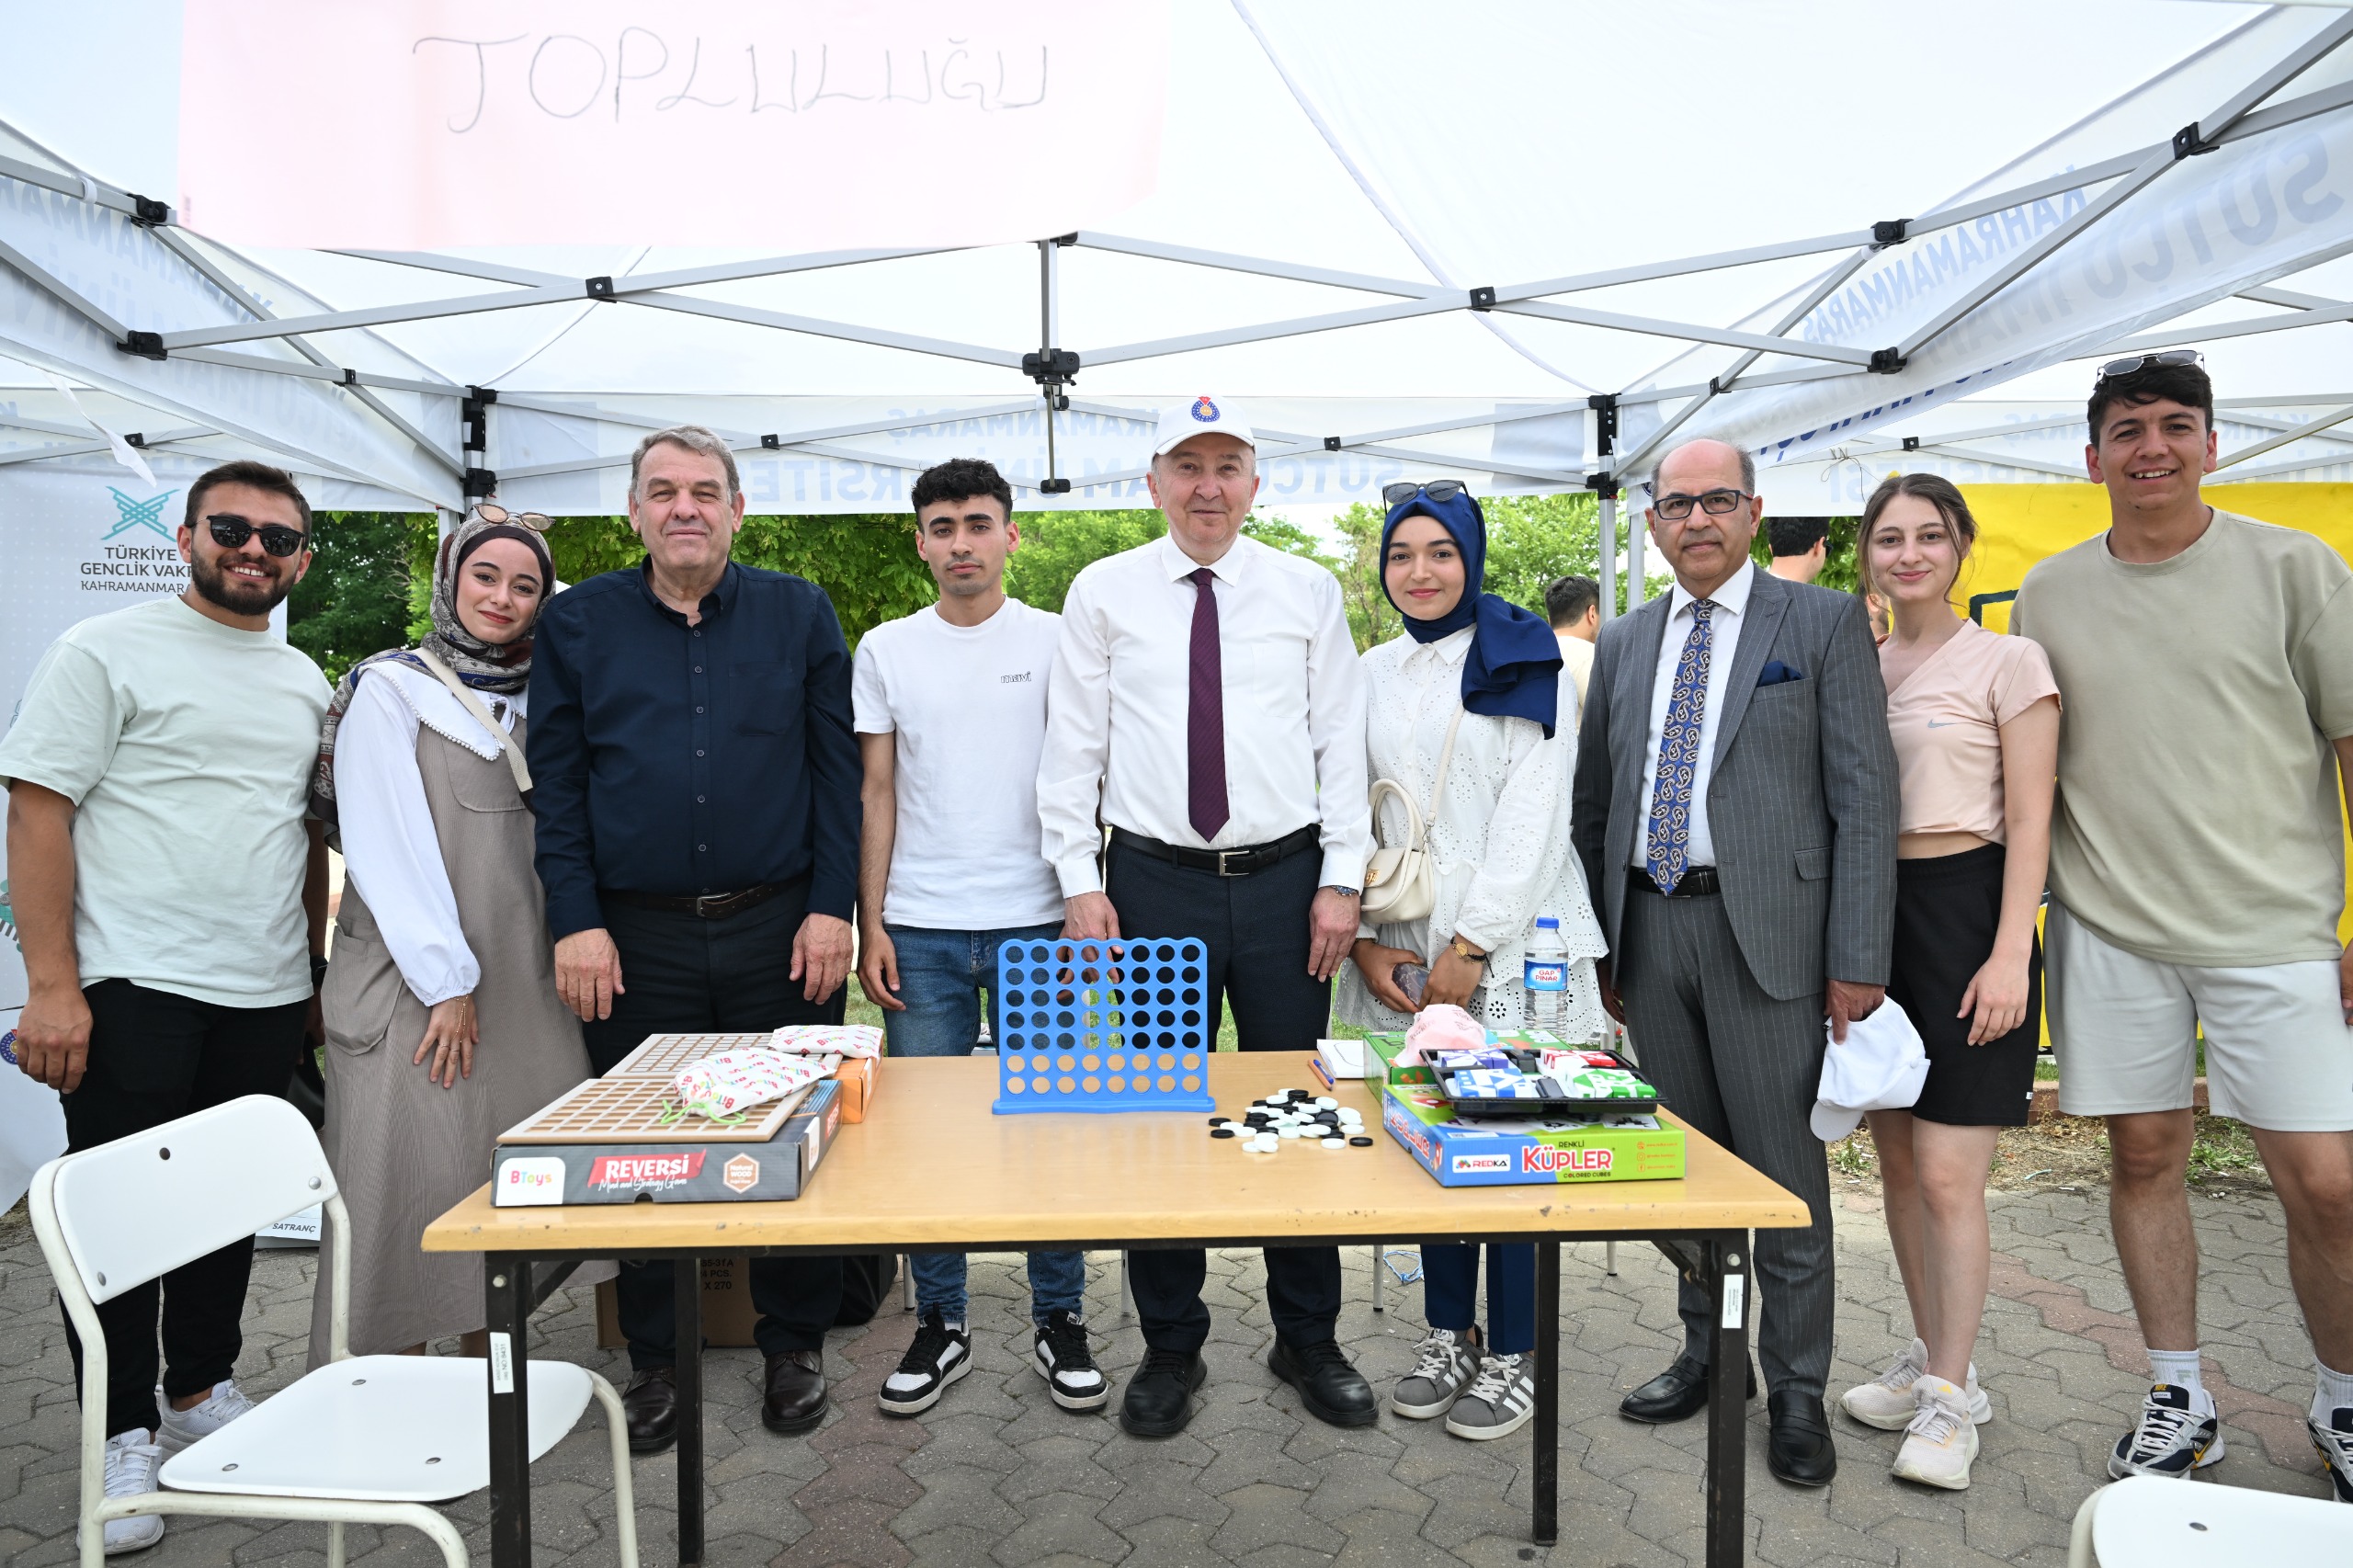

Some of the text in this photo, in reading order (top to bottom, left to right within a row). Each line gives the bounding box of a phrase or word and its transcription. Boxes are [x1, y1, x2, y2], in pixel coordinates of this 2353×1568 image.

[414, 27, 1047, 132] TOPLULUĞU
[104, 544, 176, 561] TÜRKİYE
[81, 561, 192, 577] GENÇLİK VAKF
[81, 580, 191, 593] KAHRAMANMARA
[1558, 1140, 1585, 1148] RENKLİ
[1522, 1146, 1612, 1173] KÜPLER
[510, 1170, 552, 1187] BToys
[272, 1222, 316, 1233] SATRANÇ
[704, 1281, 733, 1290] X 270
